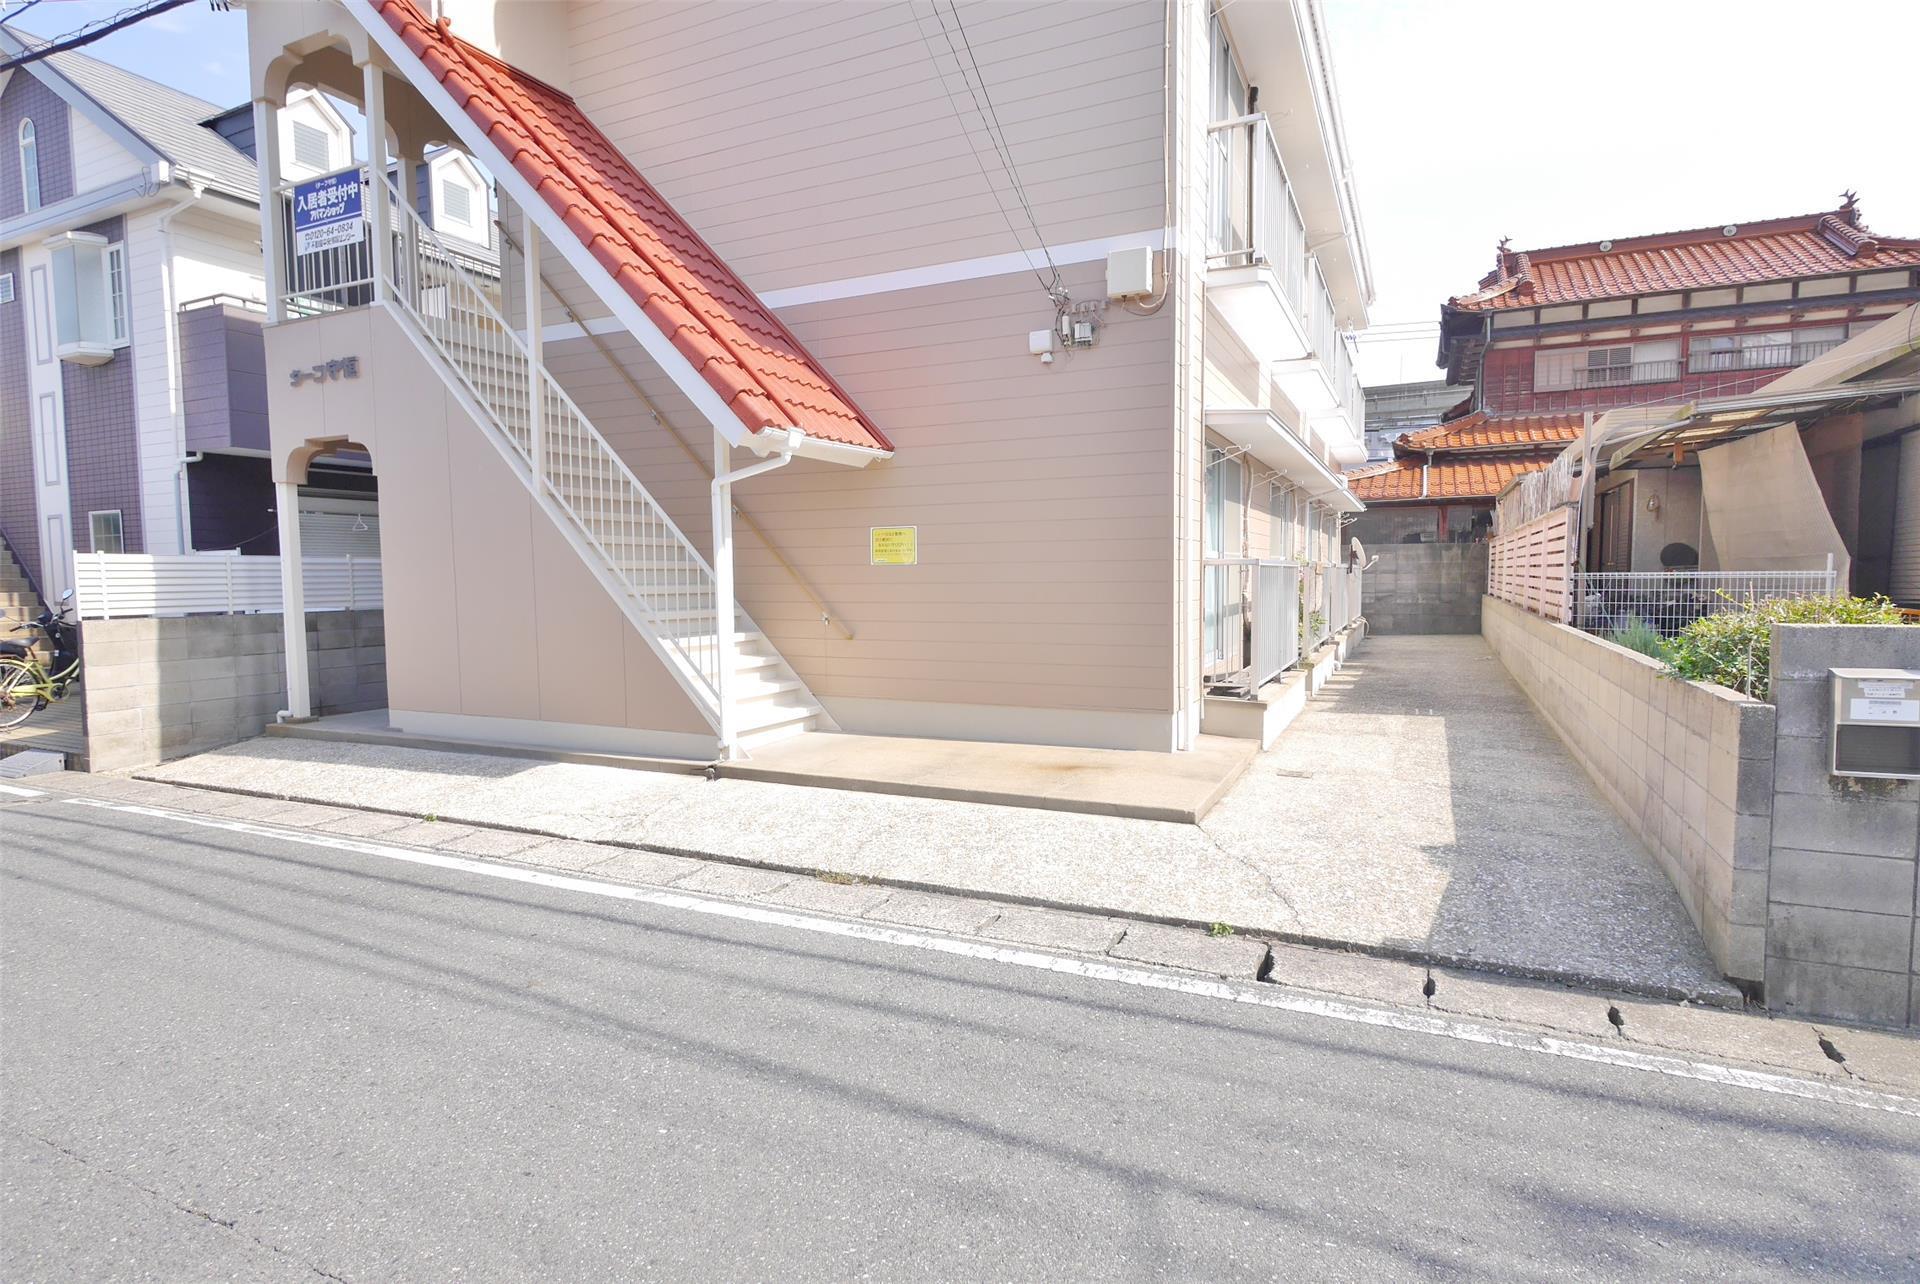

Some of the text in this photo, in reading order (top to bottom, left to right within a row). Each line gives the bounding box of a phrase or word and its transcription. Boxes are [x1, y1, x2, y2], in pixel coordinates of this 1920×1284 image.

[297, 181, 359, 213] 入居者受付中
[310, 202, 346, 221] アパマンショップ
